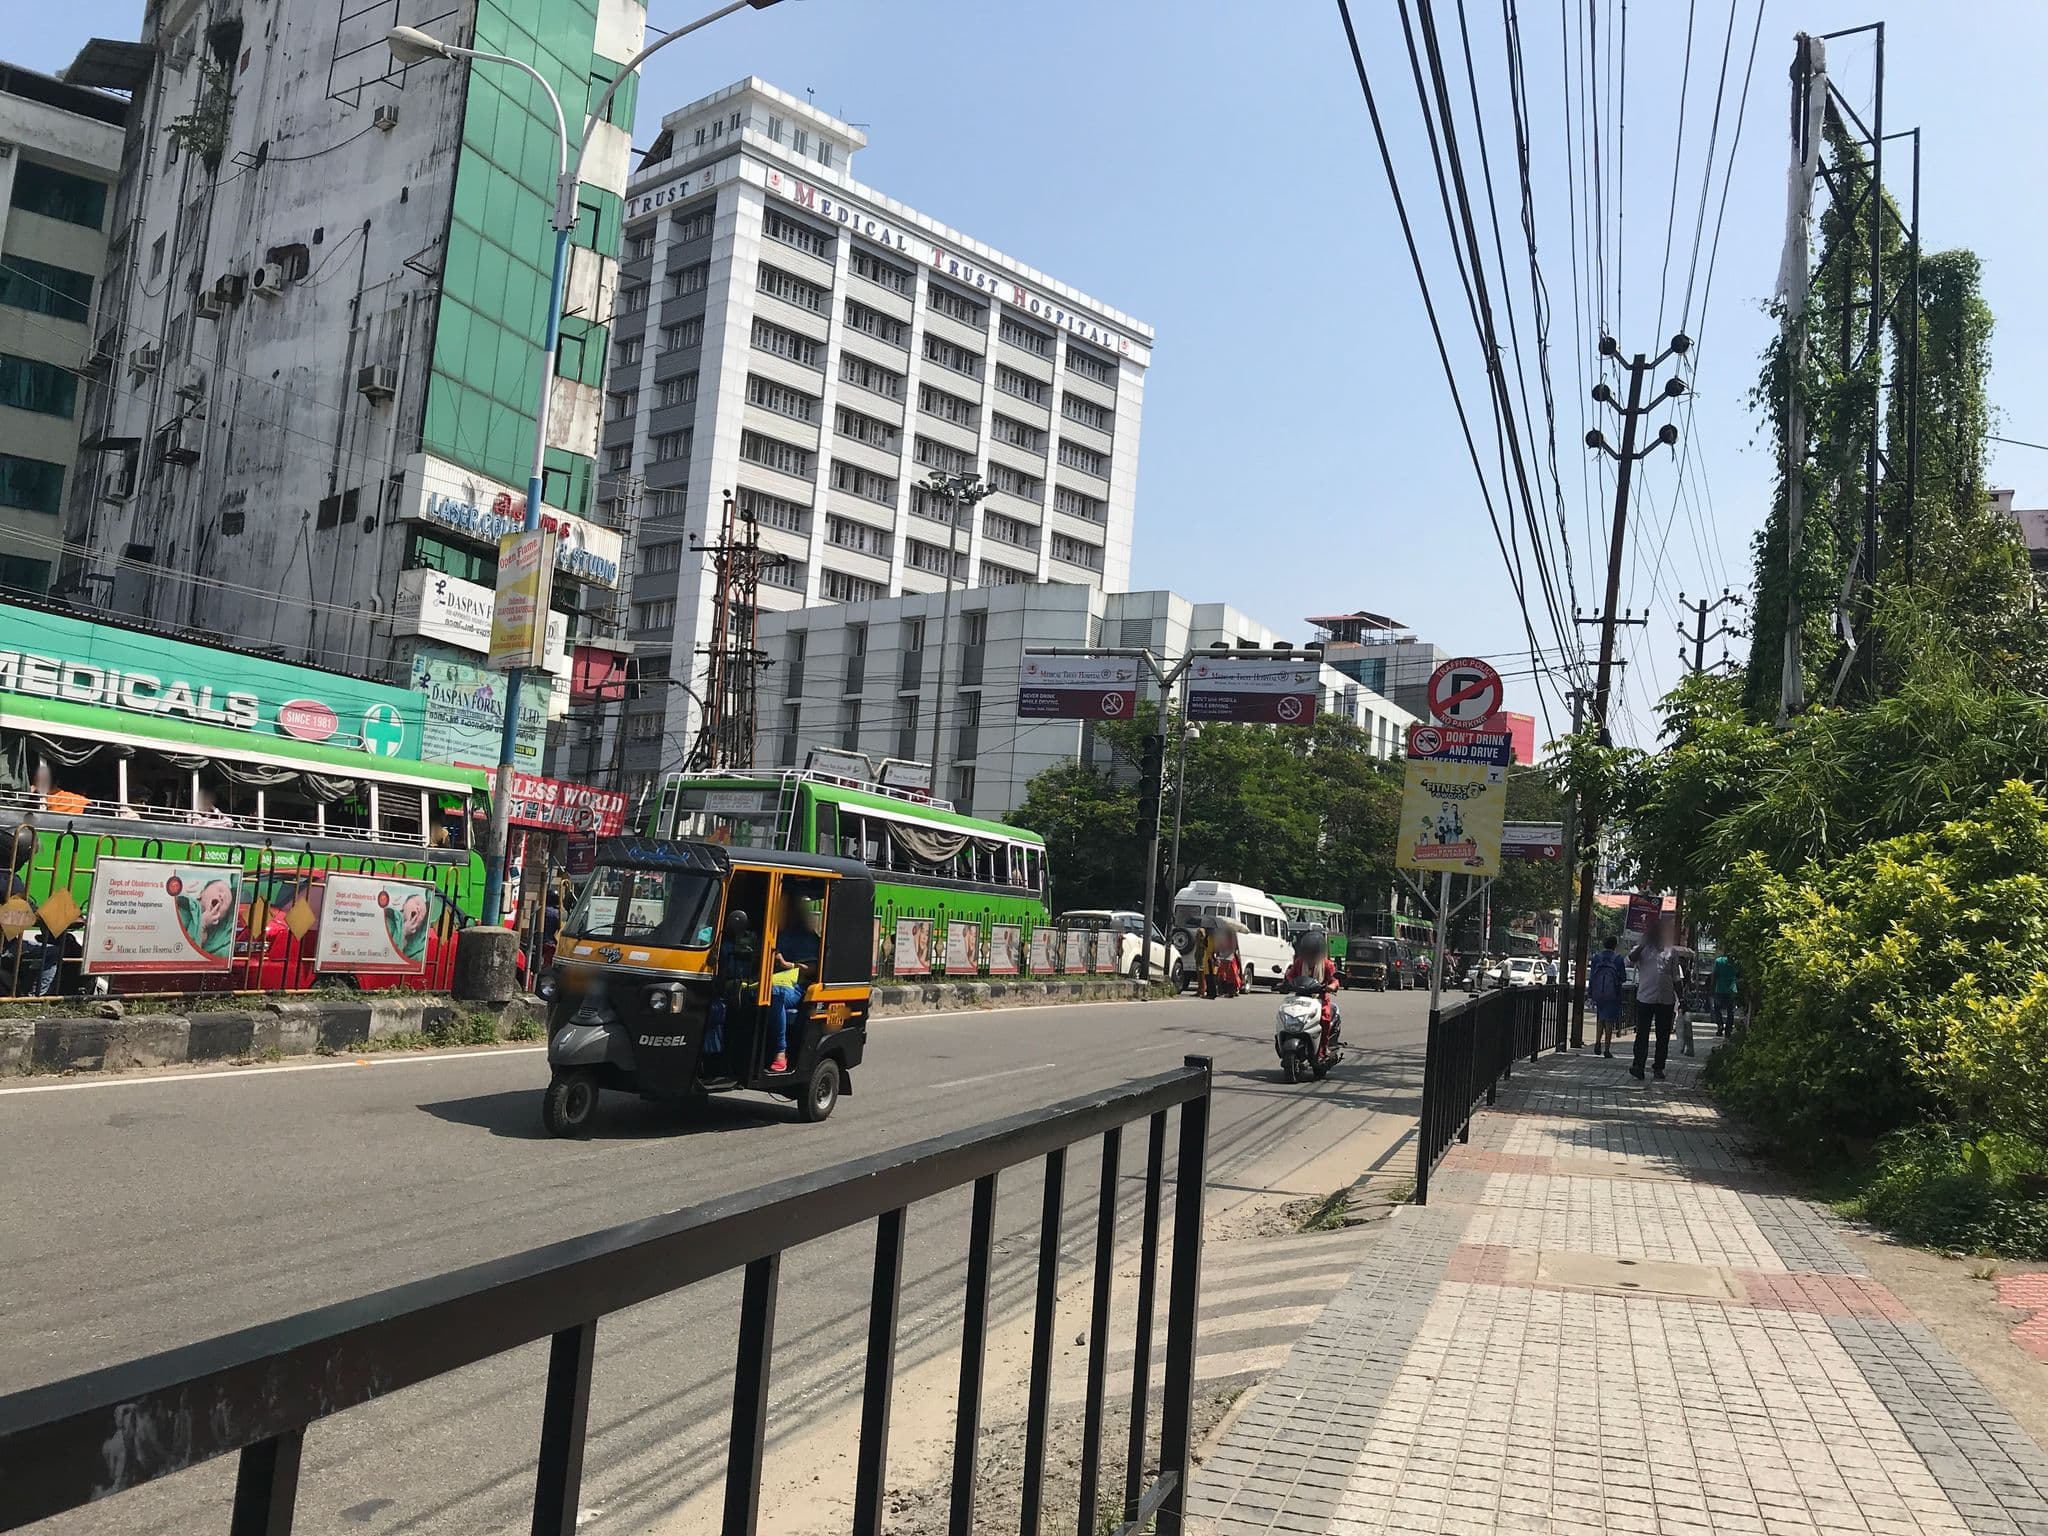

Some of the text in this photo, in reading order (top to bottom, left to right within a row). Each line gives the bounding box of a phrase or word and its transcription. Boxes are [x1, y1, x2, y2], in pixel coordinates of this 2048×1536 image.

[627, 180, 691, 219] TRUST
[793, 181, 1112, 348] MEDICAL TRUST HOSPITAL
[431, 492, 479, 531] LASER
[499, 553, 517, 569] Open
[572, 547, 617, 582] STUDIO
[447, 592, 485, 618] DASPAN
[1436, 660, 1497, 680] TRAFFIC POLICE
[431, 683, 470, 707] DASPAN
[471, 693, 505, 716] FOREX
[287, 711, 332, 729] SINCE 1981
[1440, 714, 1488, 729] NO PARKING
[1446, 731, 1505, 747] DON'T DRINK
[1448, 744, 1499, 759] AND DRIVE
[488, 772, 624, 814] RLESS WORLD
[1426, 782, 1469, 794] FITNESS
[1431, 791, 1468, 800] rewards
[106, 899, 164, 910] Cherish the happiness
[638, 1034, 688, 1047] DIESEL
